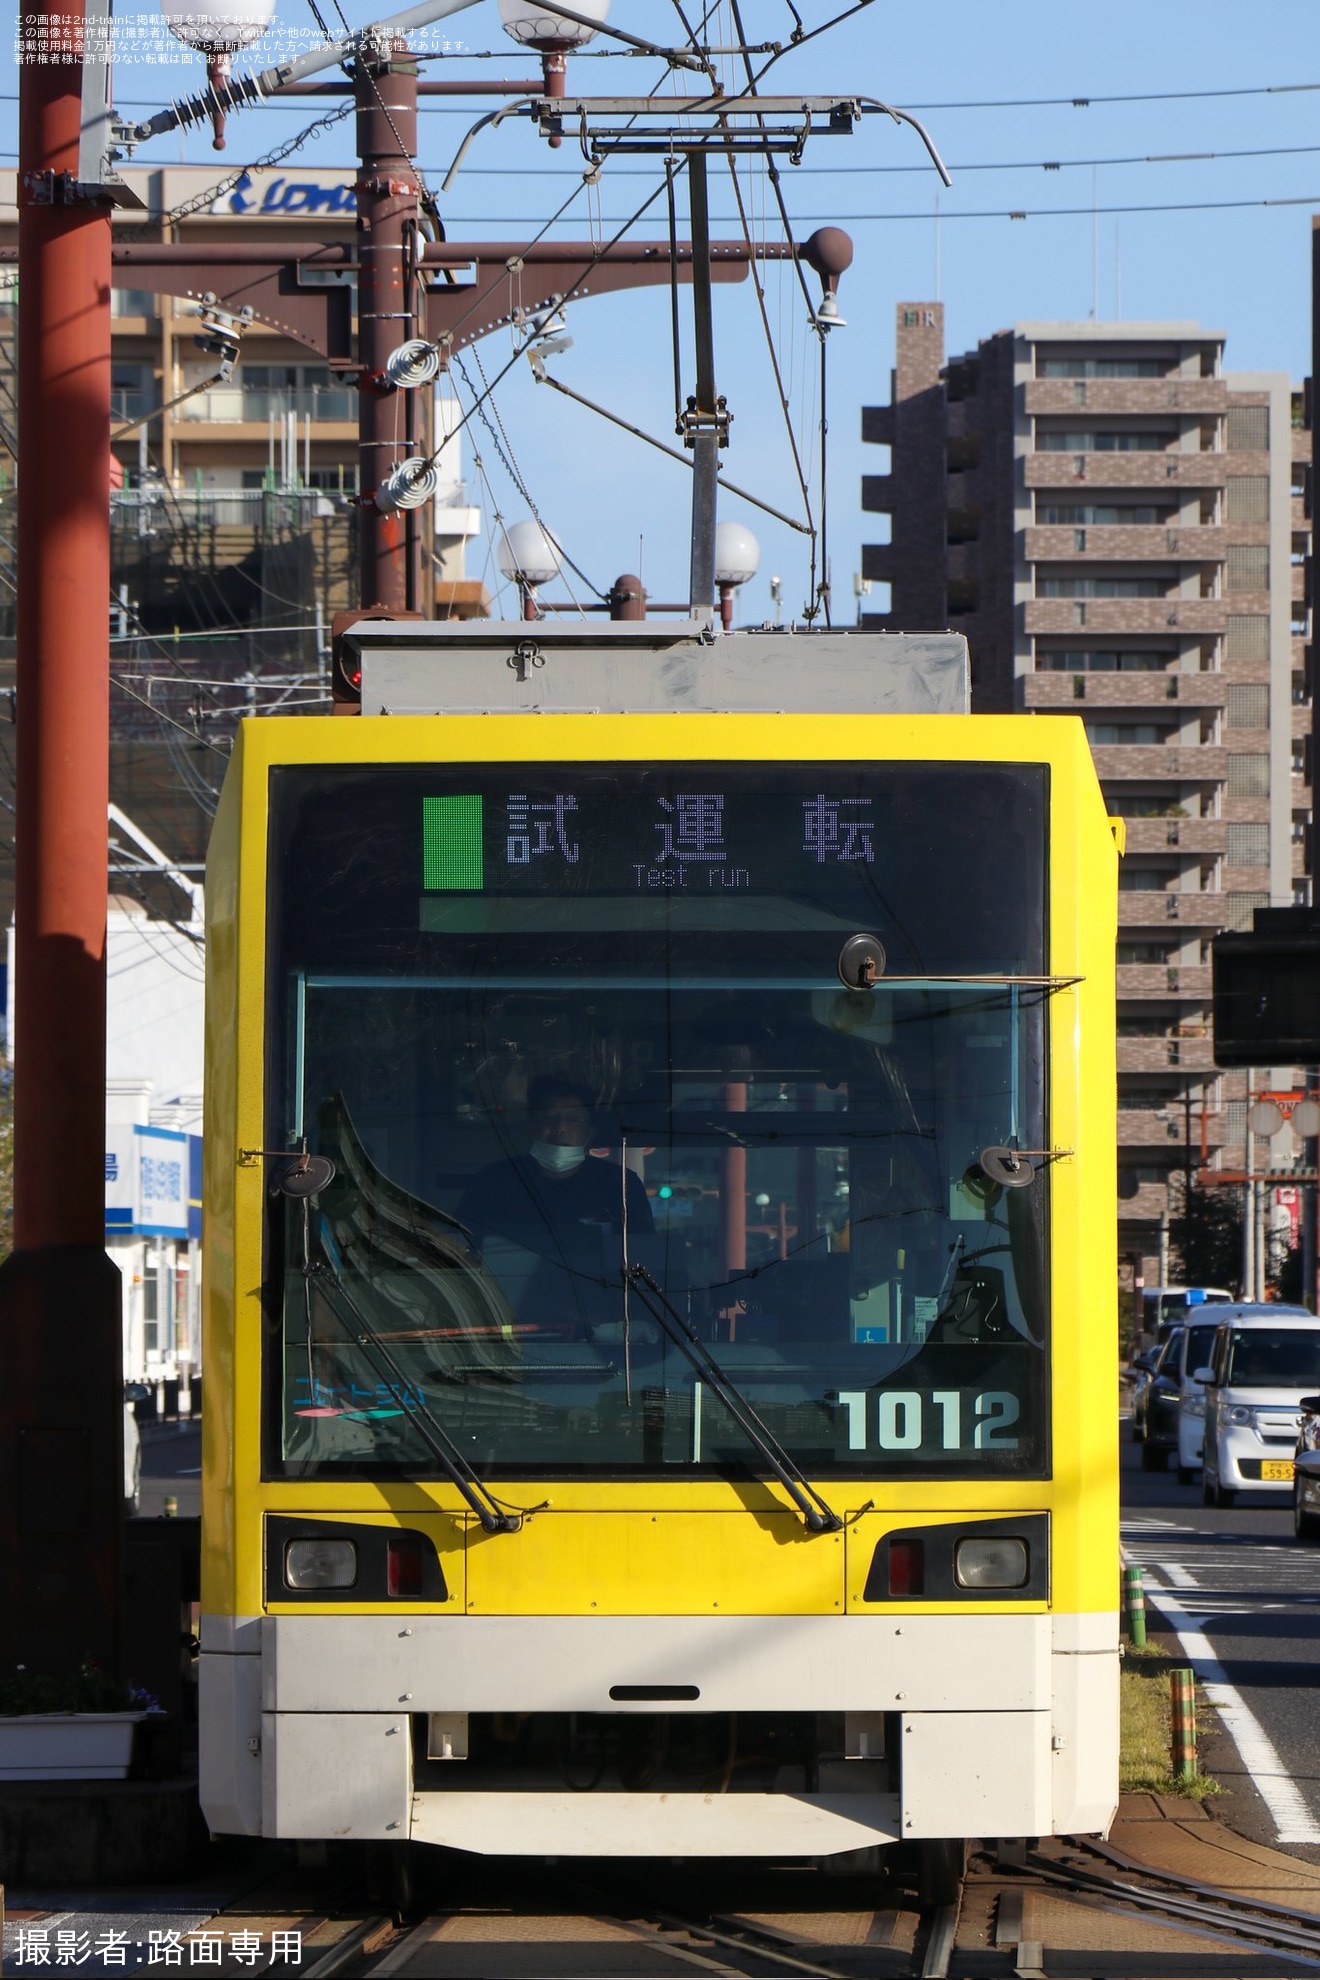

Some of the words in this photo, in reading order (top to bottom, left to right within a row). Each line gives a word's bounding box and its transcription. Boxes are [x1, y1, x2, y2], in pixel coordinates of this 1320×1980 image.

[632, 864, 689, 887] Test
[708, 867, 750, 887] run
[838, 1391, 1020, 1450] 1012
